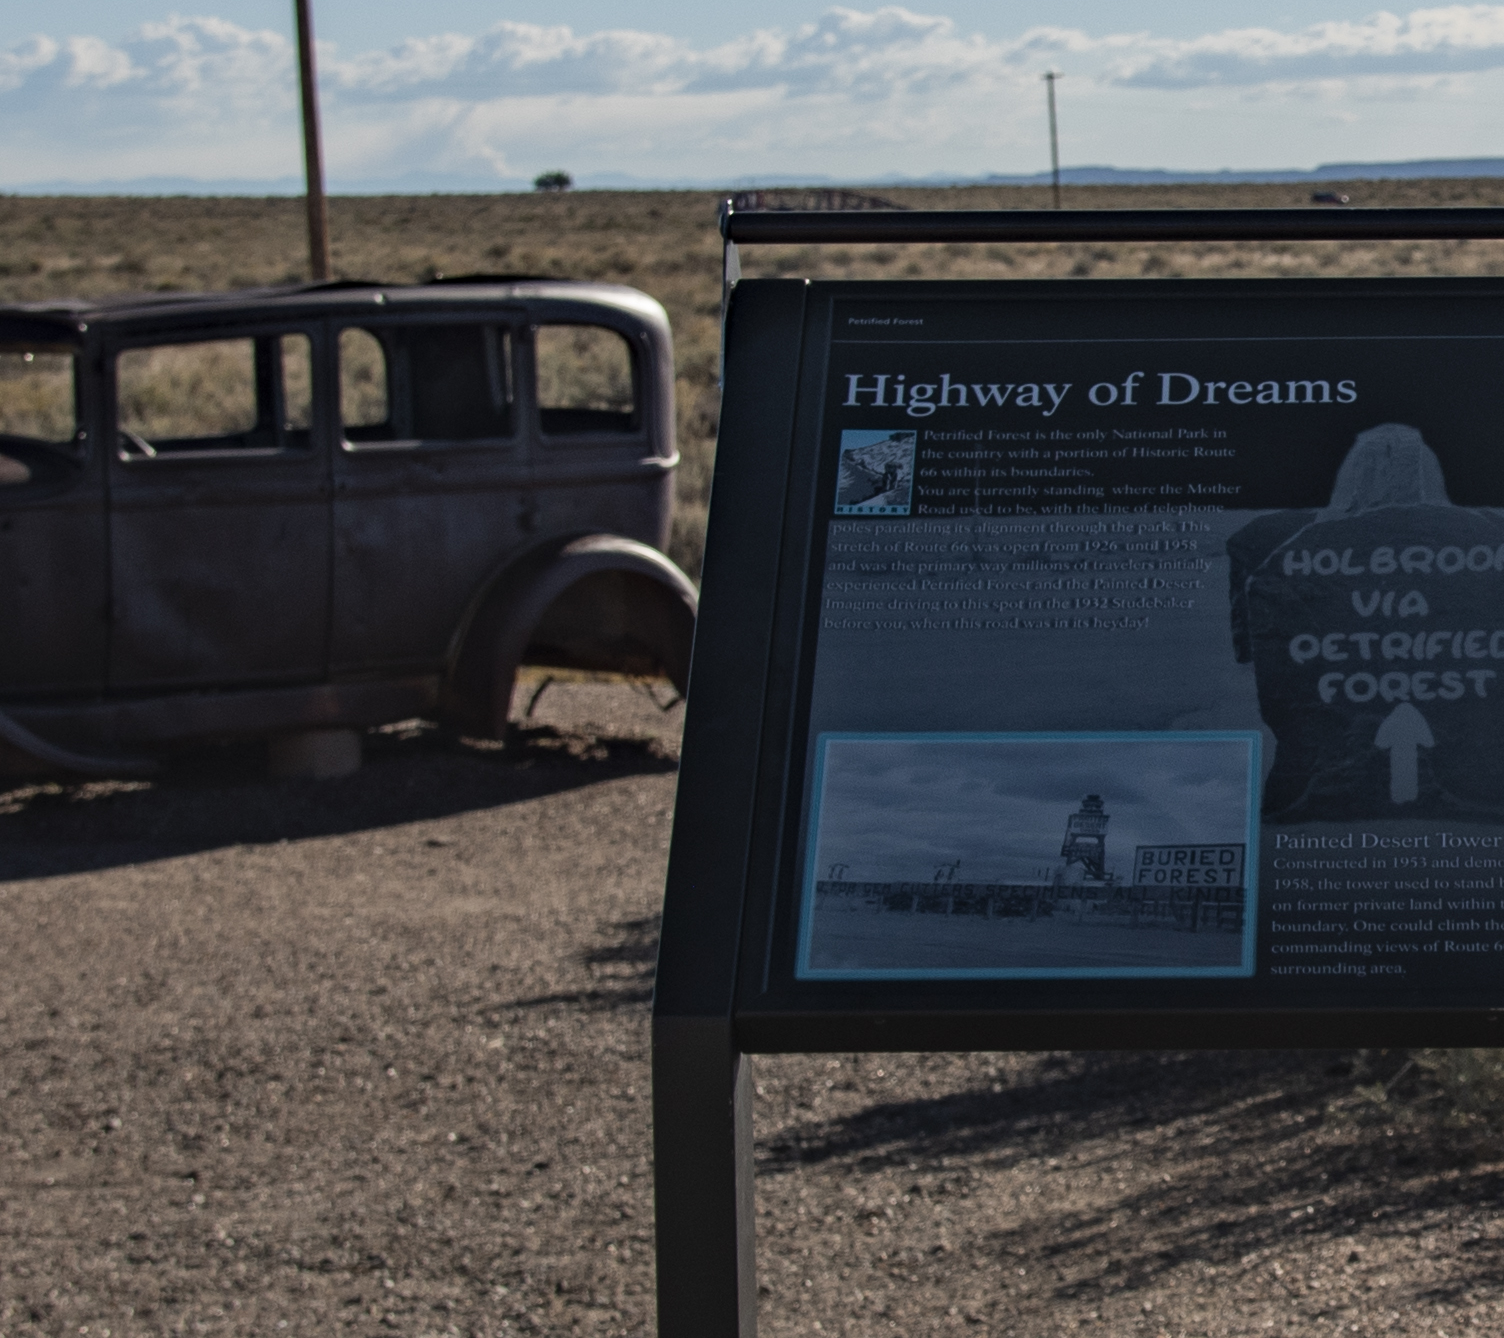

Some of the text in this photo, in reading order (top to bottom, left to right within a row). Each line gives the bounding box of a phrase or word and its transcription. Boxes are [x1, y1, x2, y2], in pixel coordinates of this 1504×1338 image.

[848, 317, 923, 326] Petrified Forest
[841, 371, 1358, 418] Highway of Dreams
[924, 428, 1227, 443] Petrified Forest is the only National Park in
[922, 446, 1236, 461] the country with a portion of Historic Route
[920, 466, 1095, 478] 66 within its boundaries.
[918, 483, 1241, 498] You are currently standing where the Mother
[918, 502, 1224, 516] Road used to be, with the line of telephone
[832, 521, 1210, 536] poles paralleling its alignment through the park. This
[1351, 590, 1429, 618] VIA
[1318, 669, 1495, 703] FOREST
[1275, 832, 1502, 849] Painted Desert Tower
[1142, 849, 1235, 866] BURIED
[1274, 857, 1367, 870] Constructed
[1372, 857, 1387, 869] in
[1392, 856, 1427, 869] 1953
[1431, 856, 1460, 869] and
[1138, 868, 1235, 884] FOREST
[1274, 878, 1314, 892] 1958,
[1318, 877, 1342, 890] the
[1346, 879, 1390, 890] tower
[1394, 877, 1429, 890] used
[1434, 878, 1450, 890] to
[1453, 877, 1495, 889] stand
[1113, 886, 1154, 901] ALL
[1272, 901, 1292, 911] on
[1297, 899, 1349, 911] former
[1353, 898, 1405, 914] private
[1409, 897, 1443, 911] land
[1447, 897, 1496, 910] within
[1271, 919, 1349, 936] boundary.
[1353, 919, 1386, 932] One
[1390, 918, 1433, 932] could
[1438, 918, 1480, 931] climb
[1271, 940, 1372, 956] commanding
[1376, 940, 1419, 953] views
[1423, 939, 1440, 952] of
[1444, 939, 1490, 952] Route
[1270, 962, 1407, 978] surrounding area.
